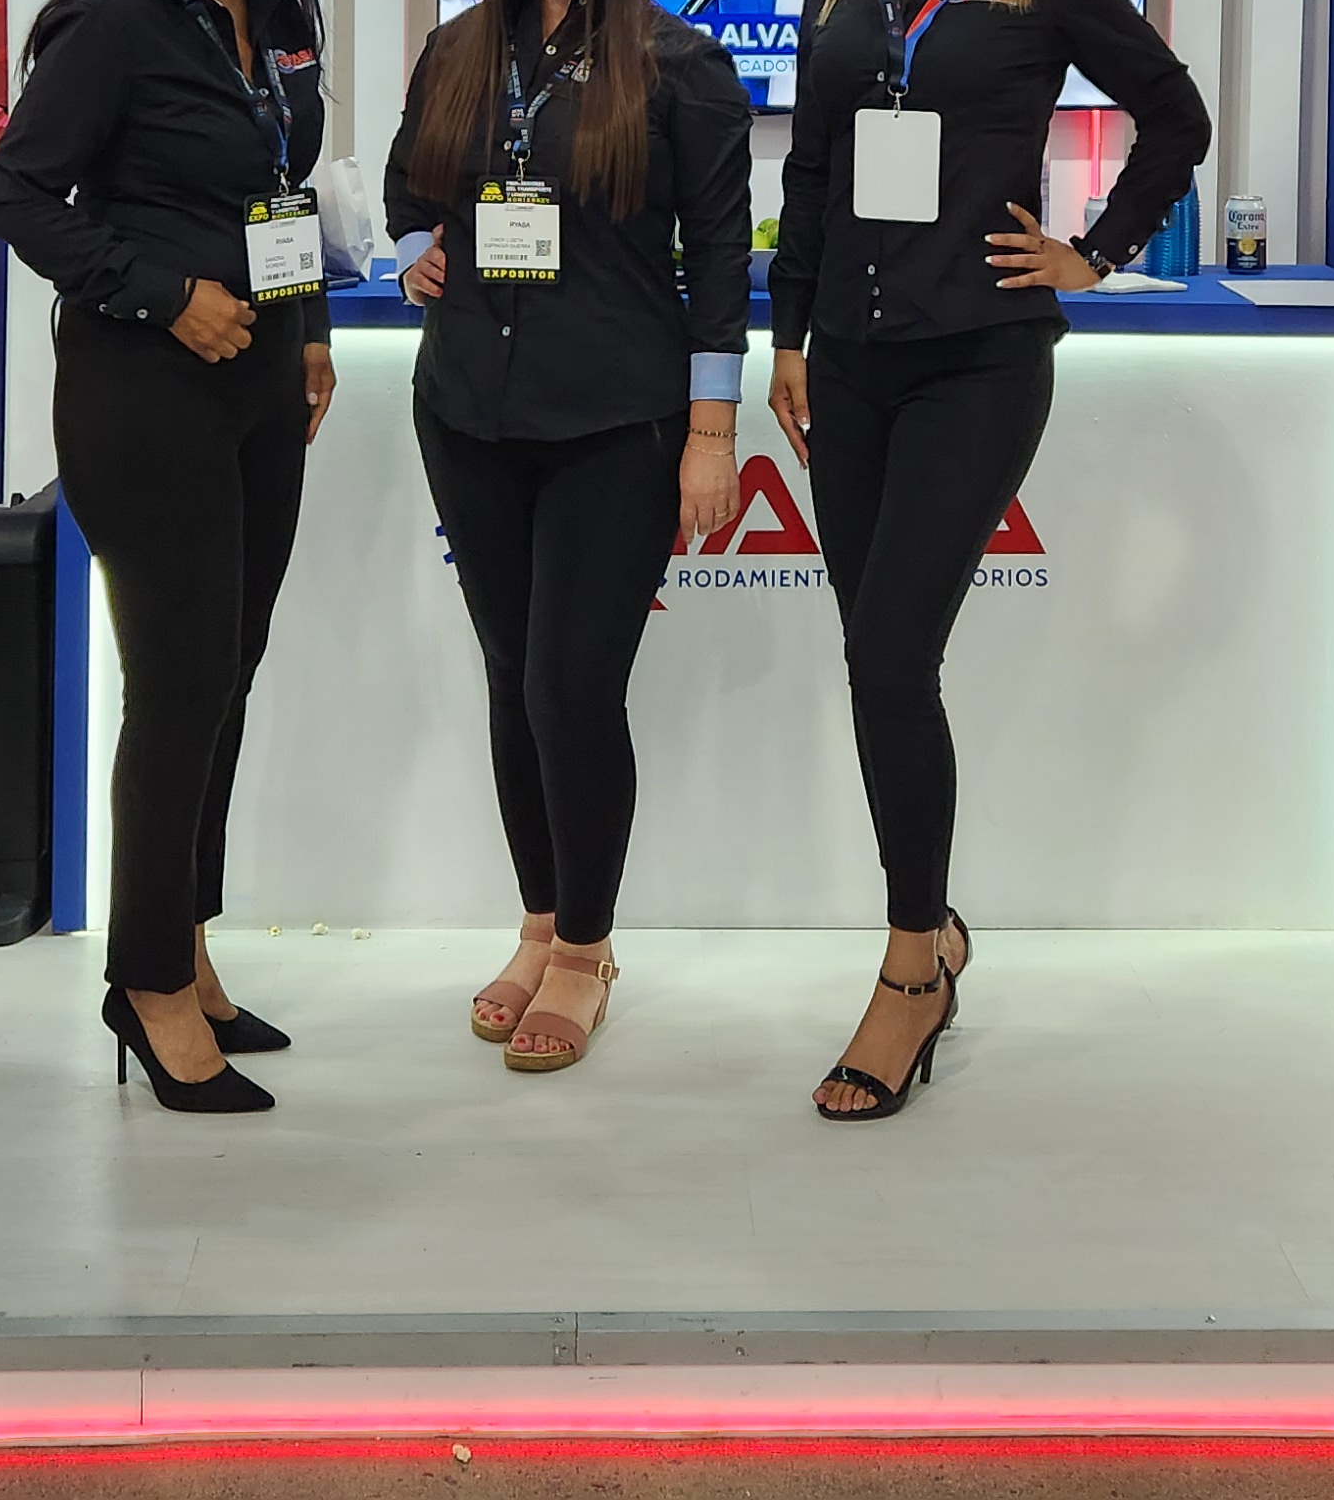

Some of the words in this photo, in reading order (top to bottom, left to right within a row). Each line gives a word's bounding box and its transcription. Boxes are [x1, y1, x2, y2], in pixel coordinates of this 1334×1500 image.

[1228, 210, 1266, 224] Corona
[1237, 222, 1259, 230] Extra
[483, 269, 555, 280] EXPOSITOR
[257, 282, 320, 301] EXPOSITOR
[679, 569, 833, 588] RODAMIENT
